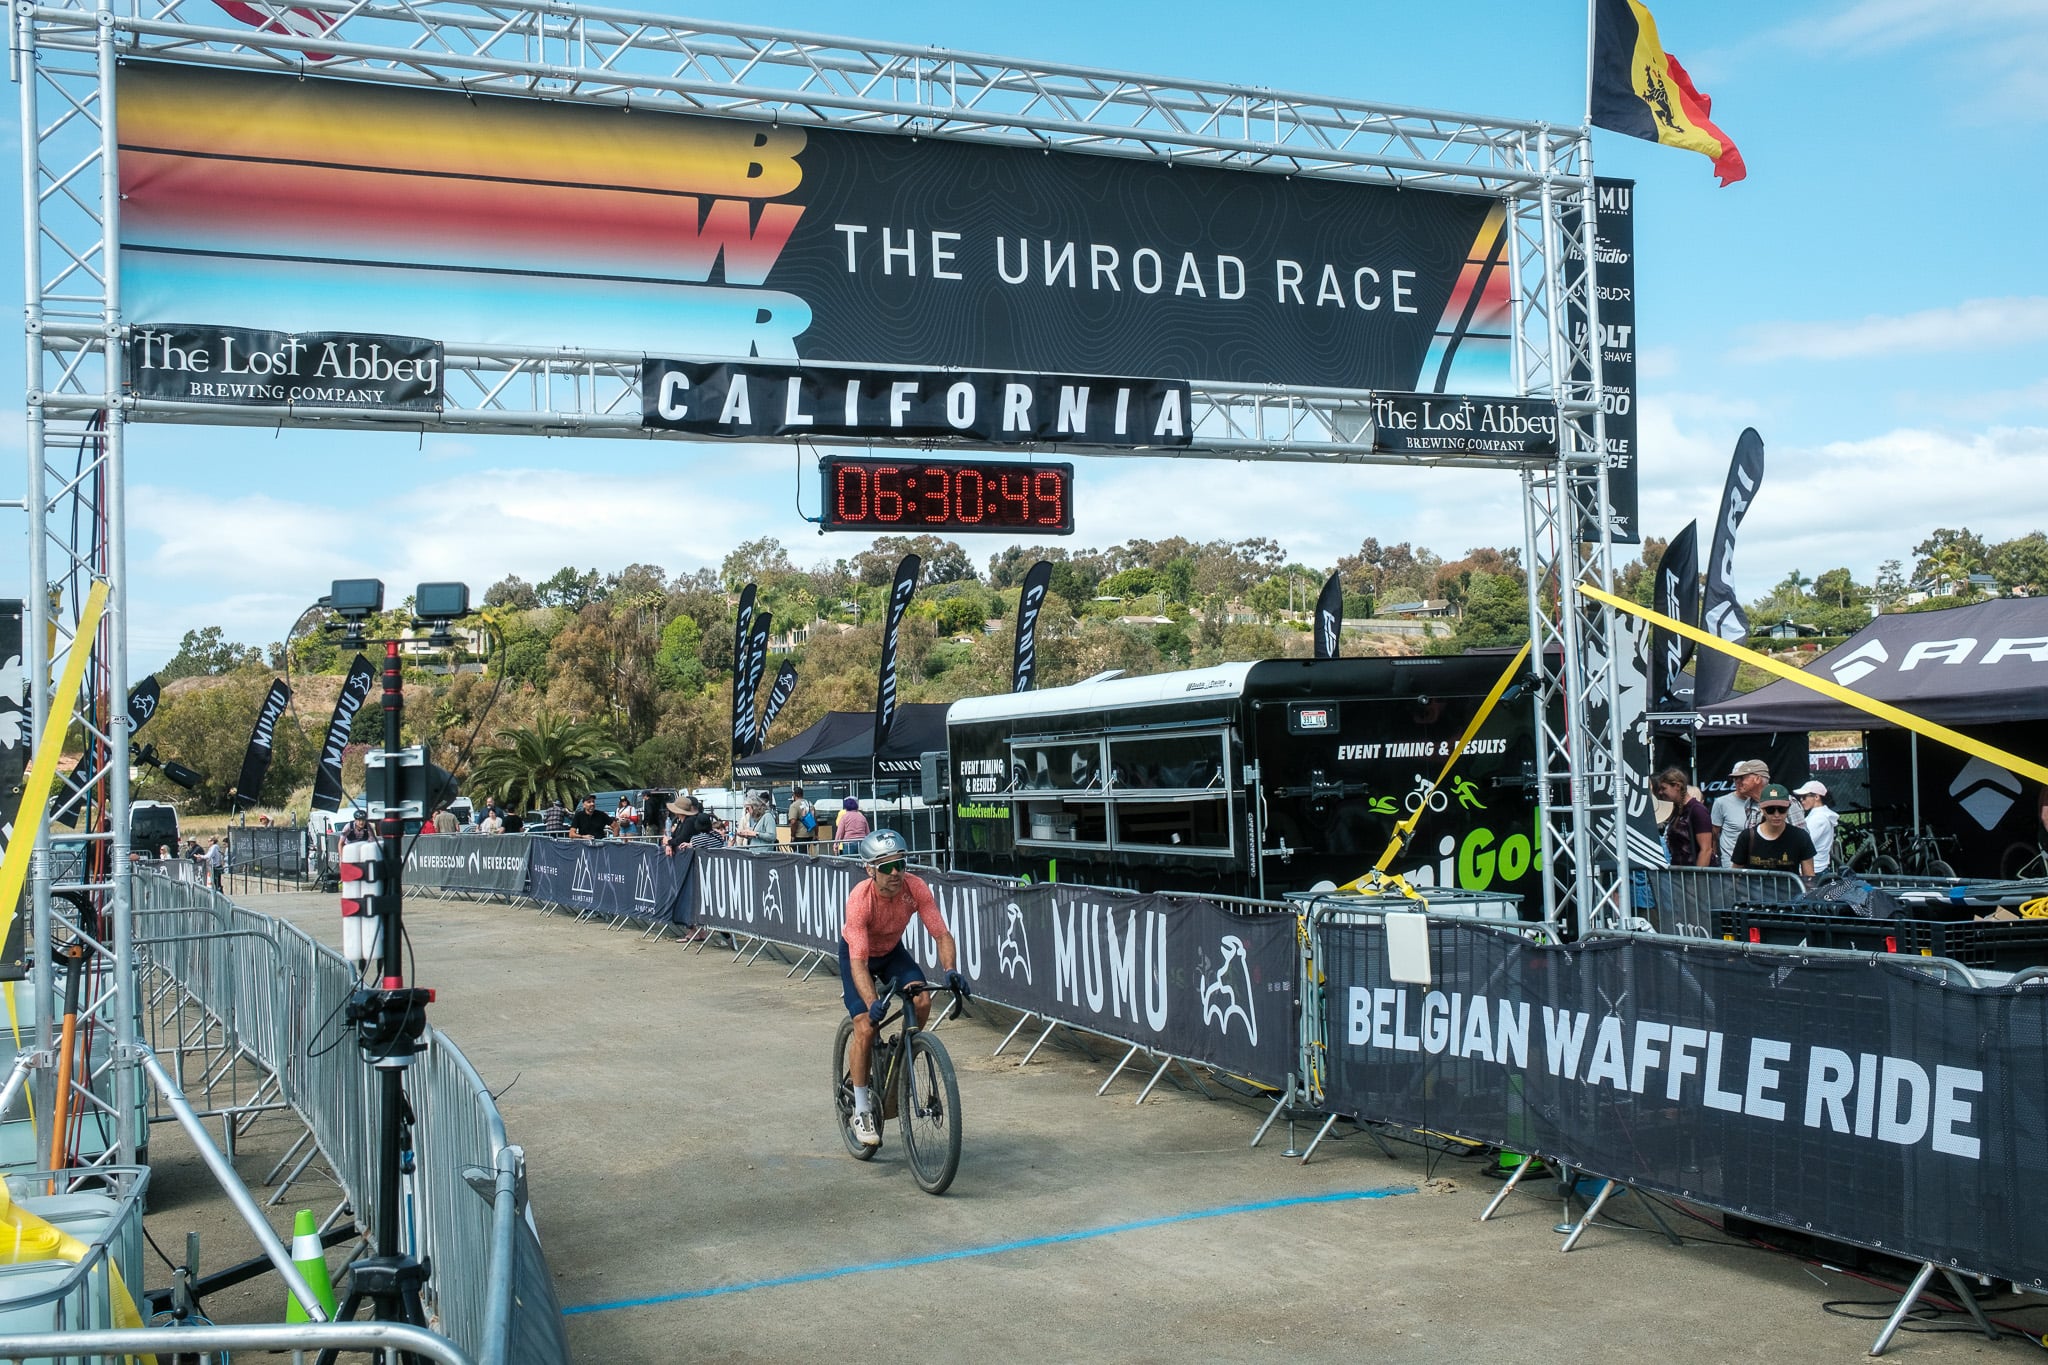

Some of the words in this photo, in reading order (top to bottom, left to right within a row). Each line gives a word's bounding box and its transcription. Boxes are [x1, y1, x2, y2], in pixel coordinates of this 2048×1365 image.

[835, 224, 963, 279] THE
[1277, 259, 1418, 314] RACE
[134, 330, 209, 372] The
[221, 336, 307, 376] Lost
[313, 342, 440, 395] Abbey
[1604, 351, 1632, 363] SHAVE
[190, 381, 284, 400] BREWING
[290, 386, 386, 403] COMPANY
[1602, 385, 1630, 394] ORMULA
[658, 370, 1185, 437] CALIFORNIA
[1602, 394, 1630, 415] 00
[1372, 399, 1417, 429] The
[1423, 402, 1475, 431] Lost
[1480, 404, 1556, 444] Abbey
[1406, 437, 1465, 450] BREWING
[1468, 438, 1526, 451] COMPANY
[837, 465, 1062, 525] 06:30:49
[1016, 584, 1044, 692] CANYO
[253, 689, 287, 749] MUMU
[1708, 713, 1748, 725] ARI
[323, 691, 361, 769] MUMU
[1337, 744, 1381, 760] EVENT
[1385, 742, 1434, 758] TIMING
[1438, 741, 1449, 756] &
[1454, 739, 1507, 755] ESULTS
[735, 766, 762, 777] CANYON
[801, 763, 832, 775] CANYON
[879, 760, 922, 772] CANYO
[961, 761, 979, 775] EVENT
[980, 759, 1003, 775] TIMING
[966, 778, 971, 793] &
[972, 777, 996, 793] RESULTS
[958, 802, 1009, 819] OmniGoEvents.com
[419, 855, 465, 869] NEVERSECOND
[698, 856, 755, 923] MUMU
[1051, 898, 1168, 1032] MUMU
[1348, 986, 1530, 1070] BELGIAN
[1543, 1005, 1792, 1122] WAFFLE
[1804, 1045, 1984, 1160] RIDE
